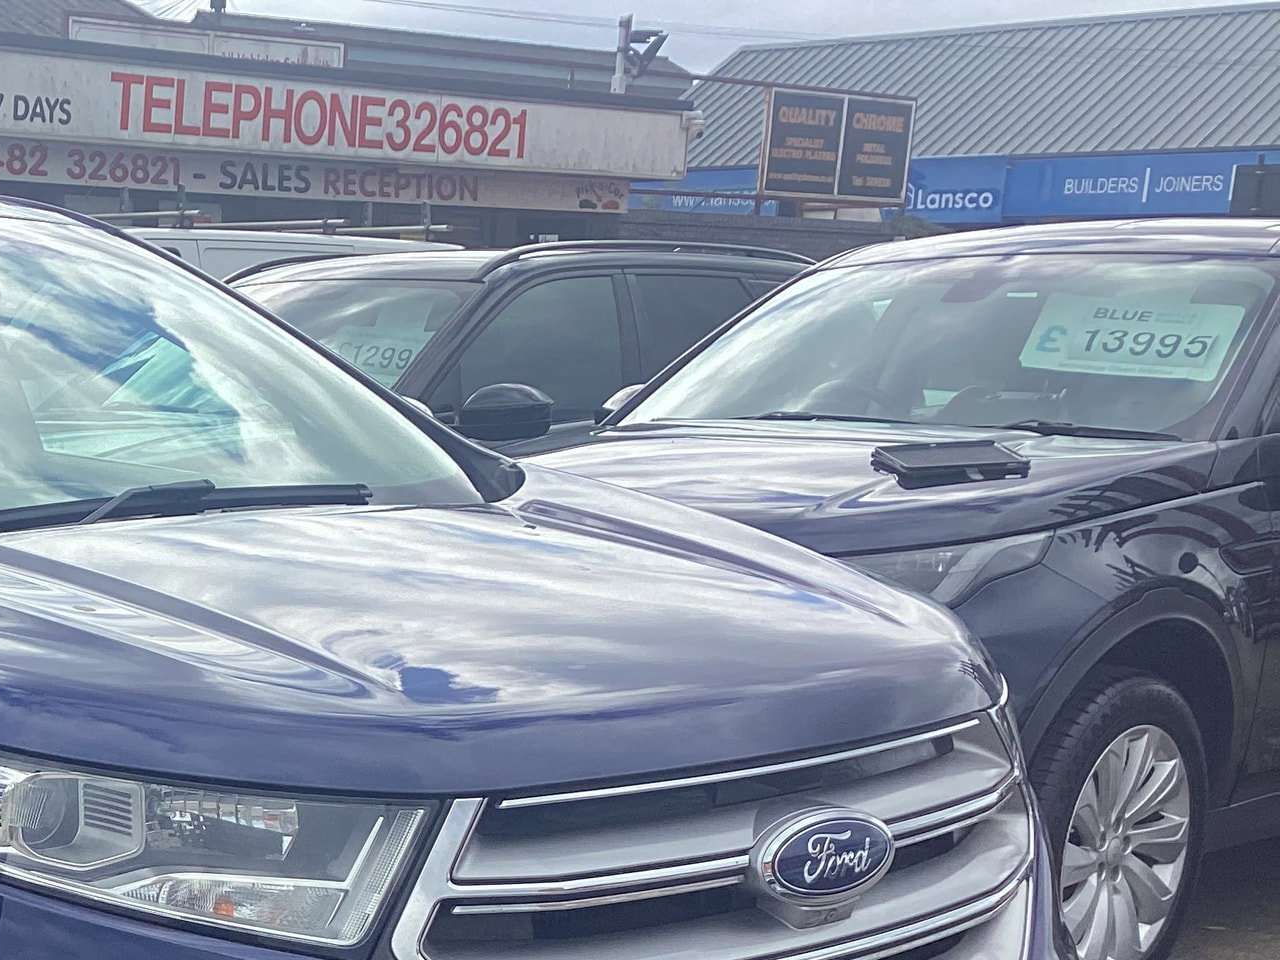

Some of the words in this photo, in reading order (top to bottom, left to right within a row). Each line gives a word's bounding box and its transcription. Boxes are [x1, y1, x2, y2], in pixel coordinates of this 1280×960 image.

[13, 95, 72, 125] DAYS
[778, 106, 836, 128] QUALITY
[852, 112, 905, 133] CHROME
[67, 148, 181, 187] 326821
[219, 162, 312, 194] SALES
[323, 167, 479, 202] RECEPTION
[1064, 176, 1139, 195] BUILDERS
[1154, 175, 1224, 193] JOINERS
[916, 188, 993, 209] Lansco
[1093, 307, 1154, 323] BLUE
[1083, 329, 1214, 359] 13995
[803, 830, 871, 883] Ford
